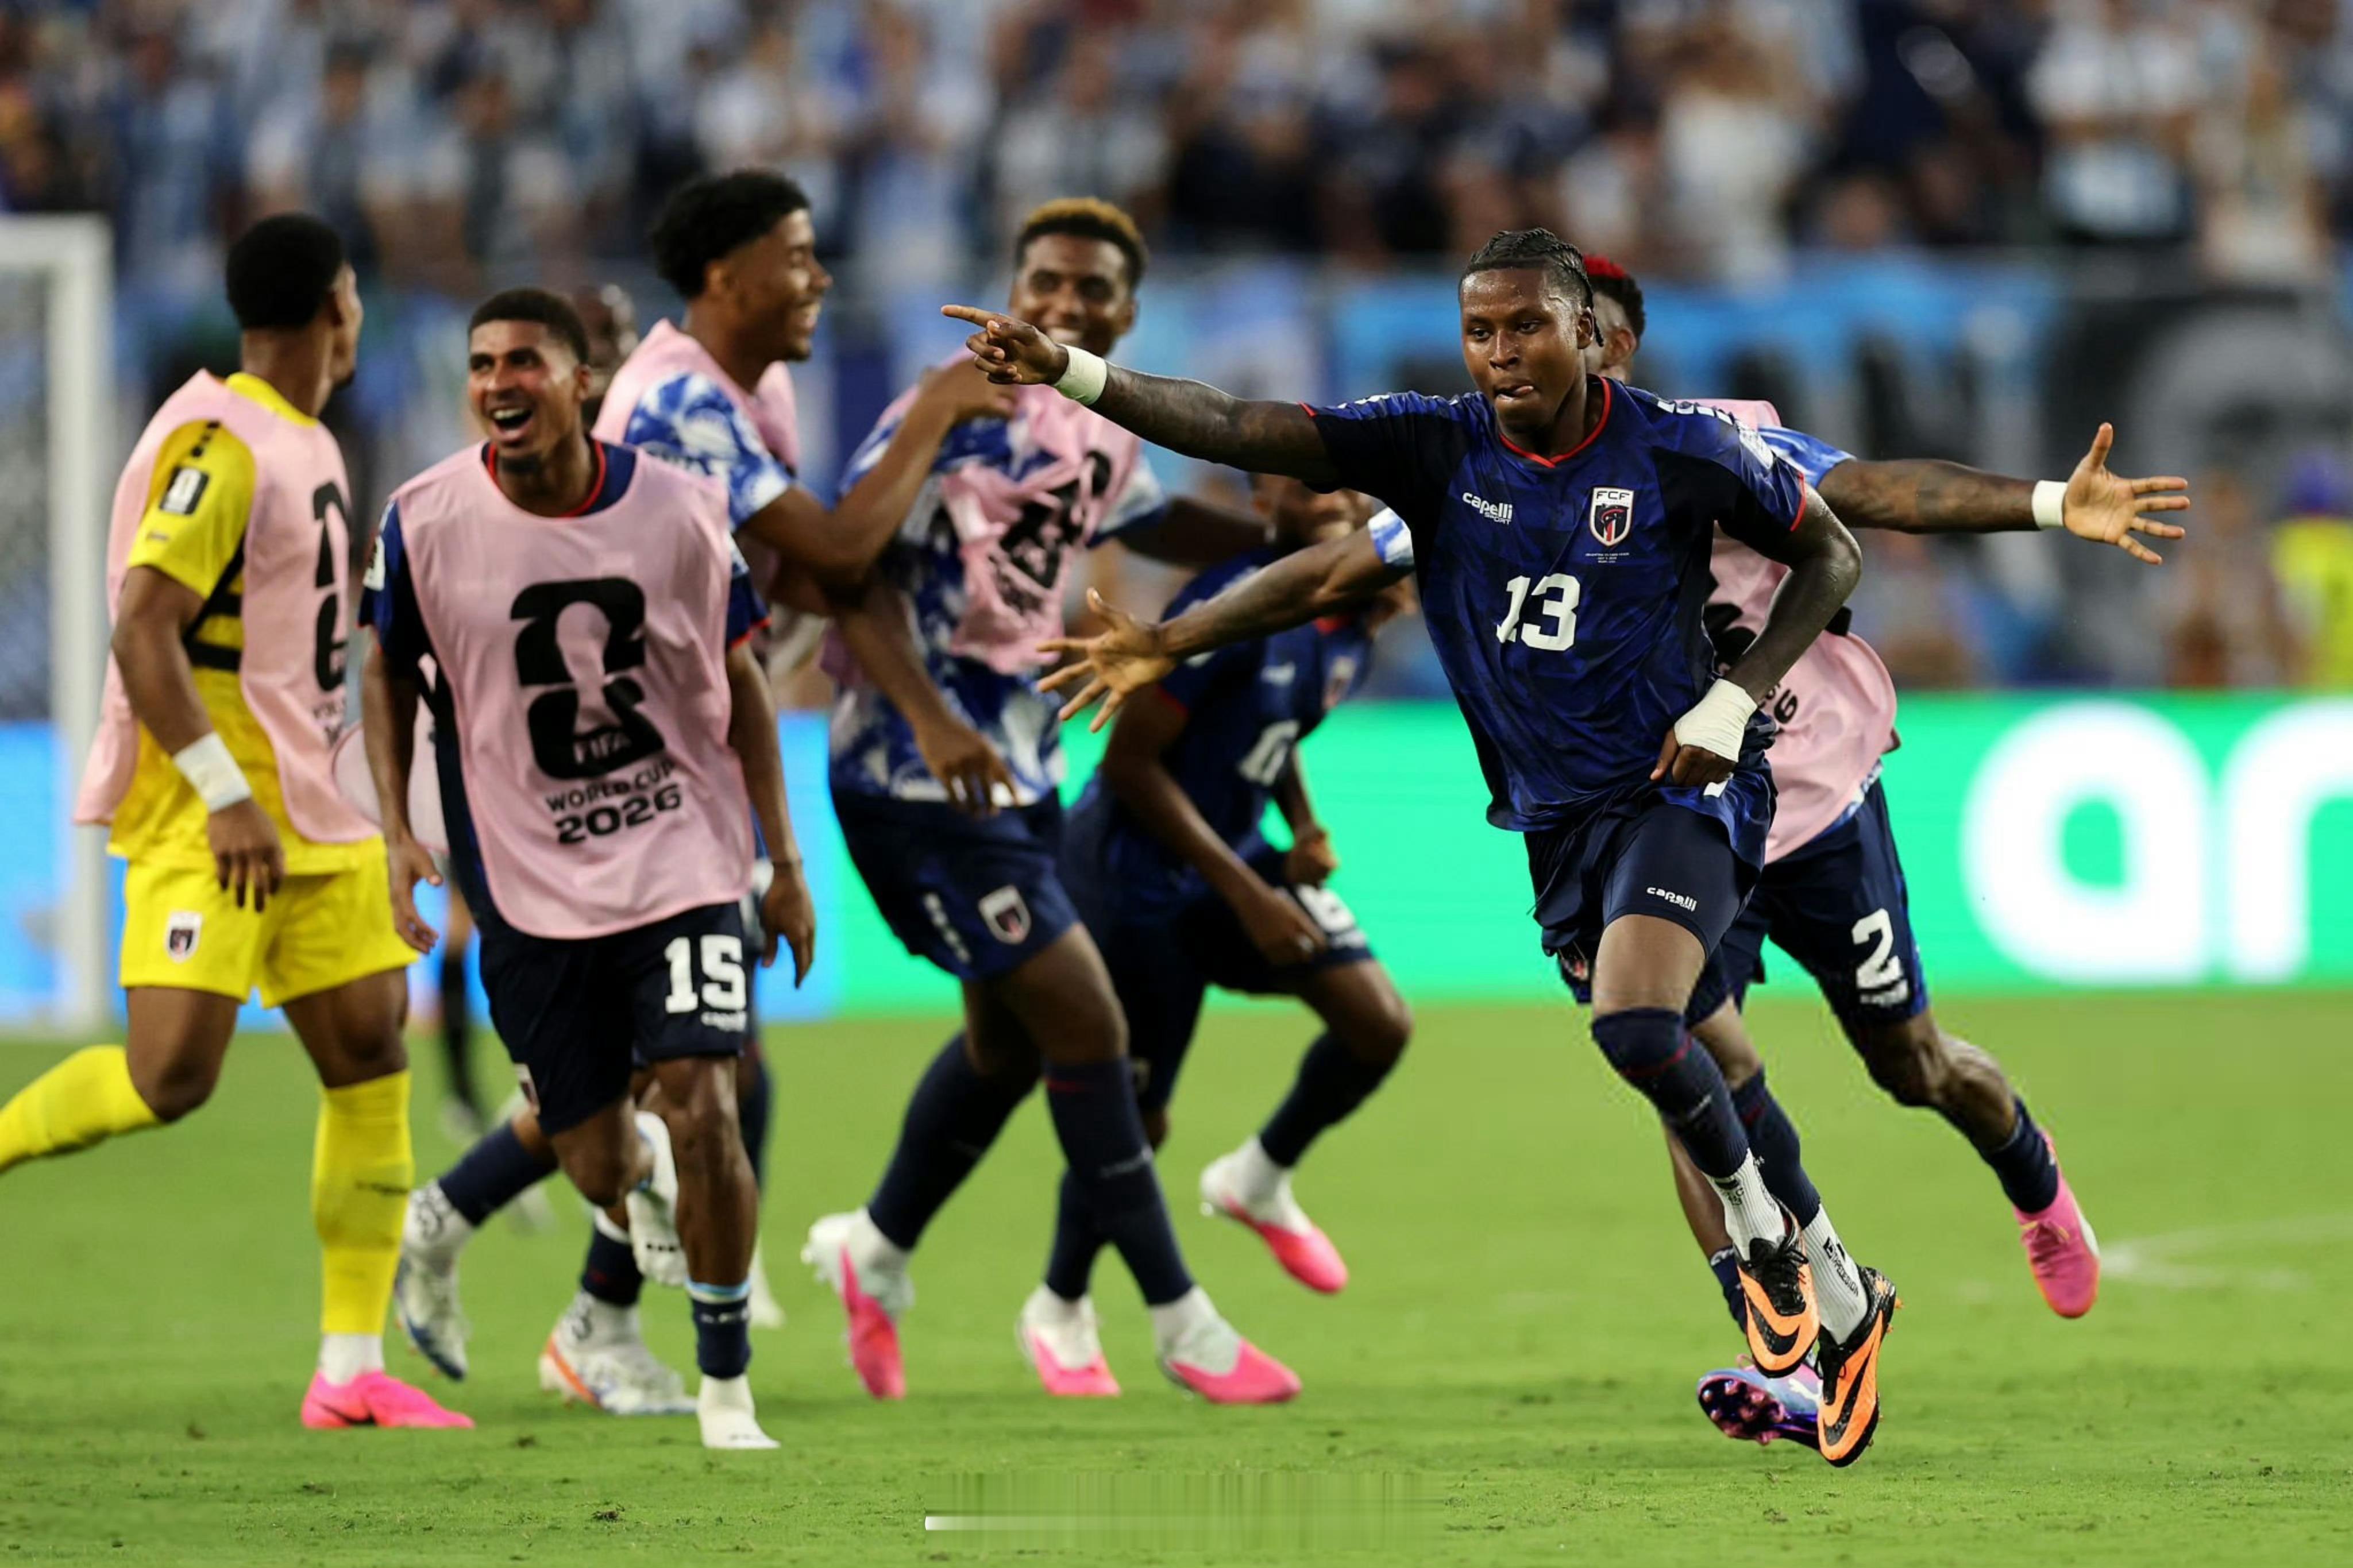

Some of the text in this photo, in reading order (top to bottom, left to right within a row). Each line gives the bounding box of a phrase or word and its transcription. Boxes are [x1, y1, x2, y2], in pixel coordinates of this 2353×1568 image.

[1462, 492, 1513, 519] capelli
[1596, 490, 1630, 501] FCF
[1496, 573, 1580, 651] 13
[546, 757, 675, 813] WORLD CUP
[555, 784, 681, 845] 2026
[1646, 887, 1698, 912] capelli
[664, 934, 746, 1014] 15
[1851, 907, 1903, 989] 2
